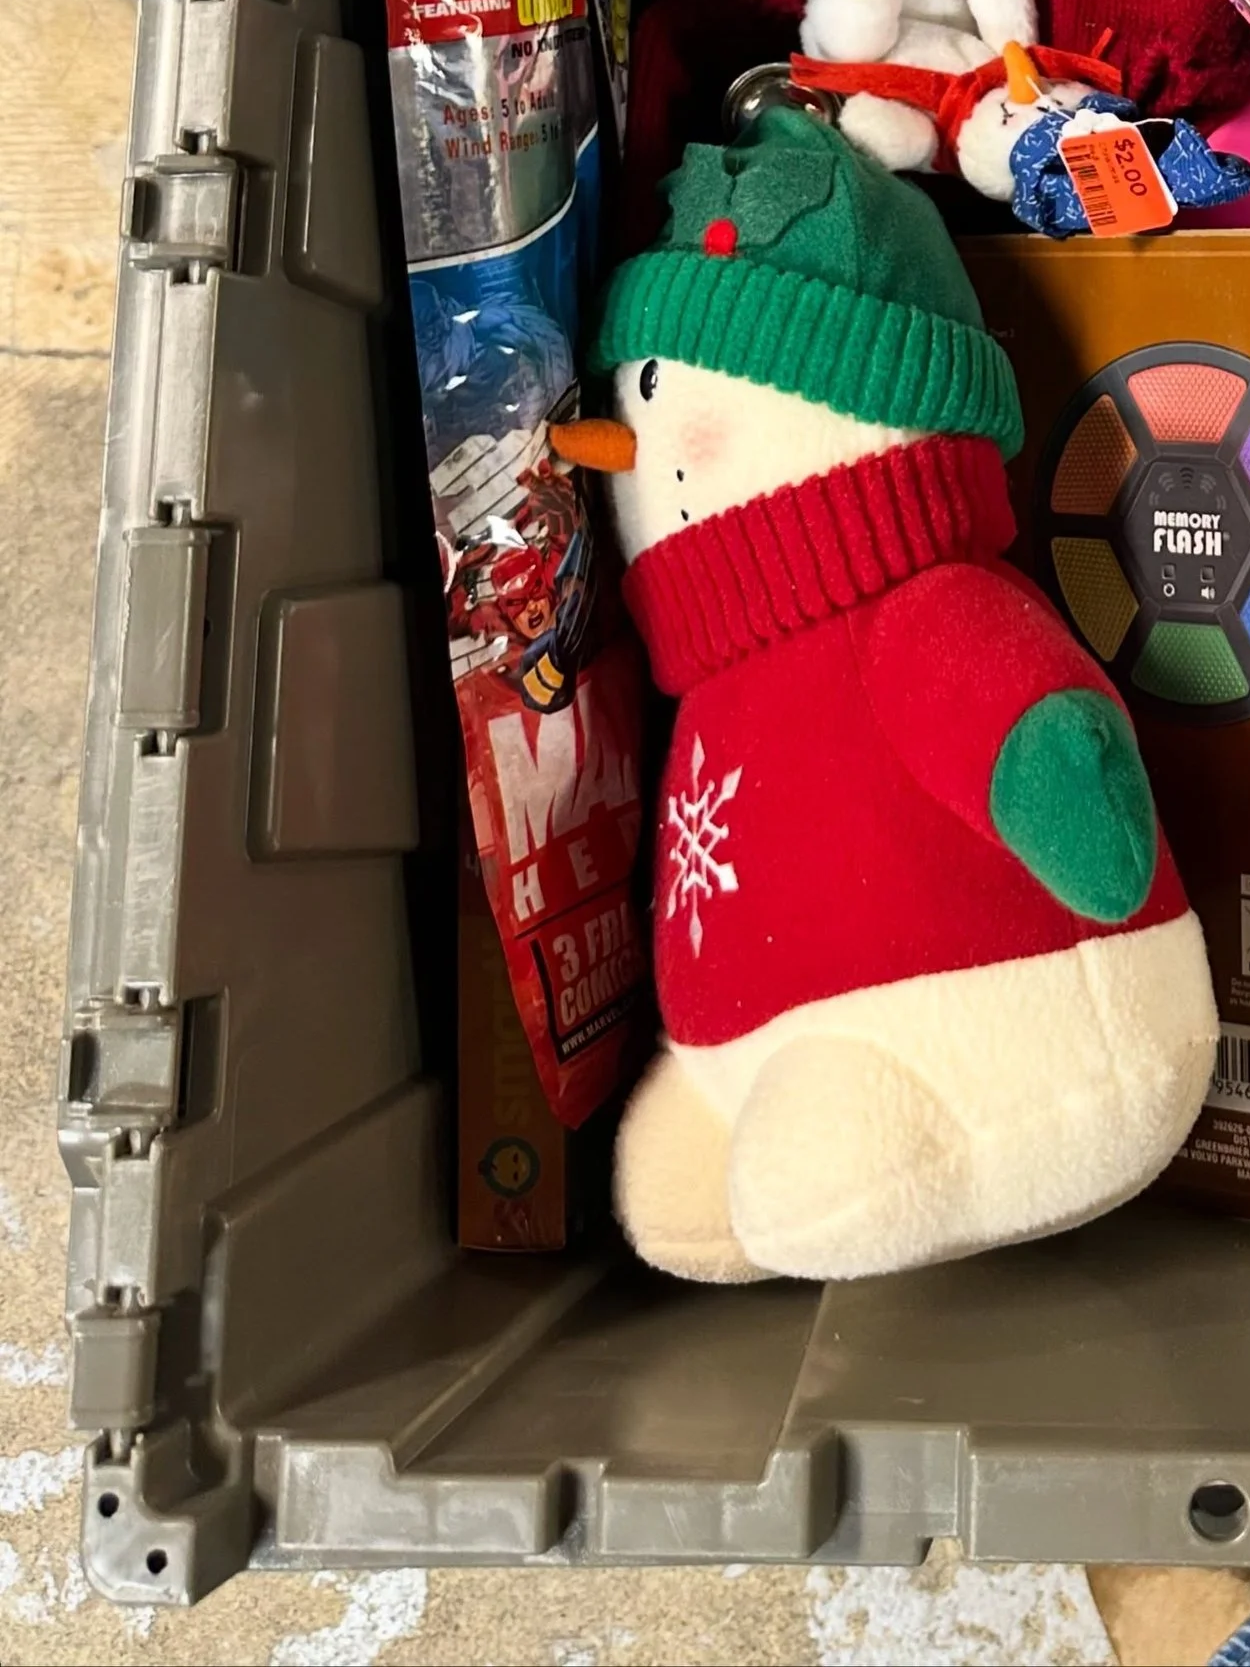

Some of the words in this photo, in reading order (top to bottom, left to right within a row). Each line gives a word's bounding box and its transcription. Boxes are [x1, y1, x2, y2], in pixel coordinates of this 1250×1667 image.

[511, 41, 533, 59] NO
[444, 103, 495, 128] Ages:
[501, 98, 510, 118] 5
[514, 100, 526, 117] to
[444, 135, 492, 160] Wind
[500, 130, 538, 153] Range:
[1114, 138, 1148, 197] $2.00
[1153, 510, 1222, 531] MEMORY
[1153, 529, 1223, 557] FLASH
[552, 933, 580, 983] 3
[1190, 1148, 1219, 1164] VOLVO
